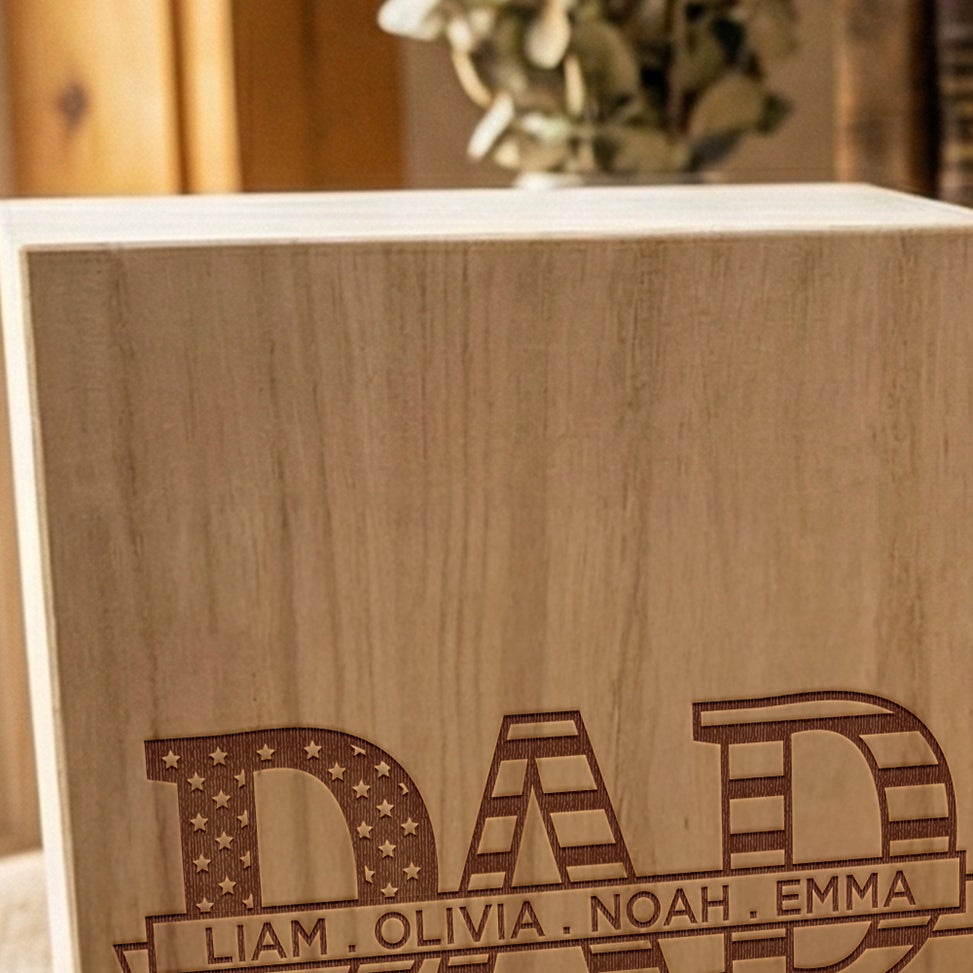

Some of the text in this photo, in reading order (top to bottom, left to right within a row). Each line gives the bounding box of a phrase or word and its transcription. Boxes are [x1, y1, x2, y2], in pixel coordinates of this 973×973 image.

[204, 870, 916, 965] LIAM OLIVIA NOAH EMMA
